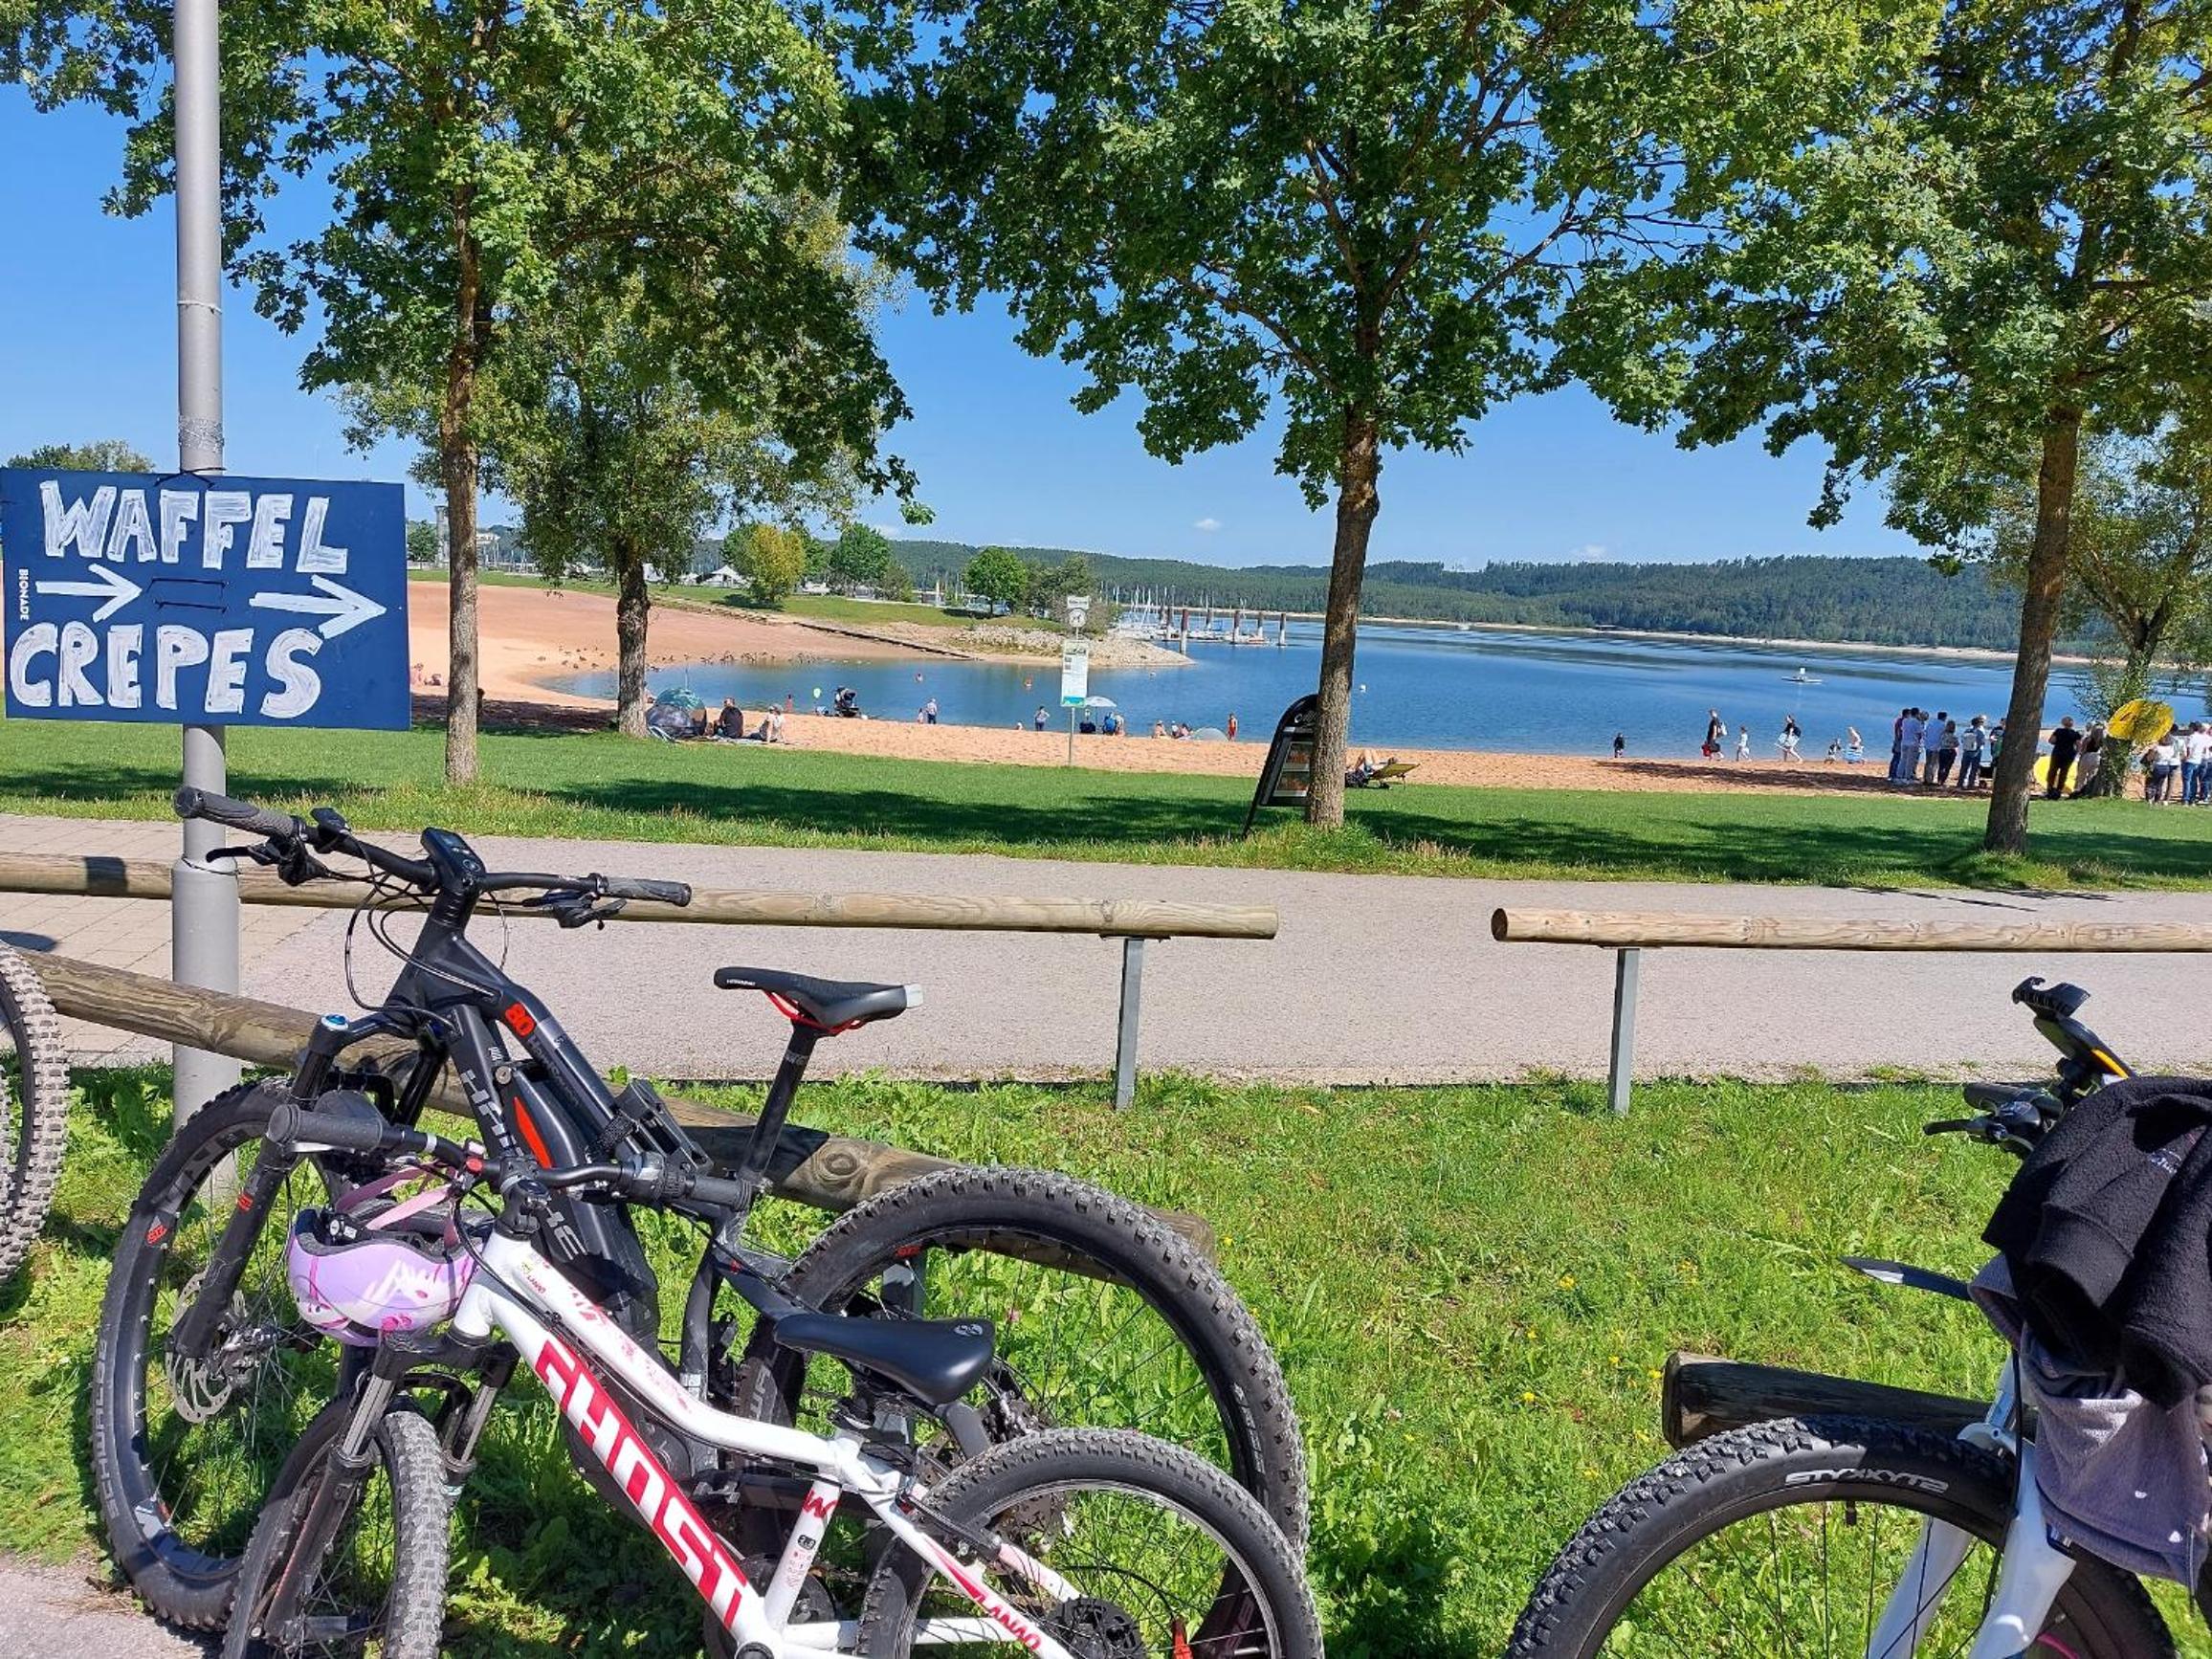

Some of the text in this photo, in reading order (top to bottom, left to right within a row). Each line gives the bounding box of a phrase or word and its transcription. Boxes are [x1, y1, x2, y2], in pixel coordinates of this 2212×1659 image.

[39, 480, 348, 573] WAFFEL
[18, 568, 30, 621] BIONADE
[10, 621, 323, 718] CREPES
[537, 1335, 749, 1634] GHOST
